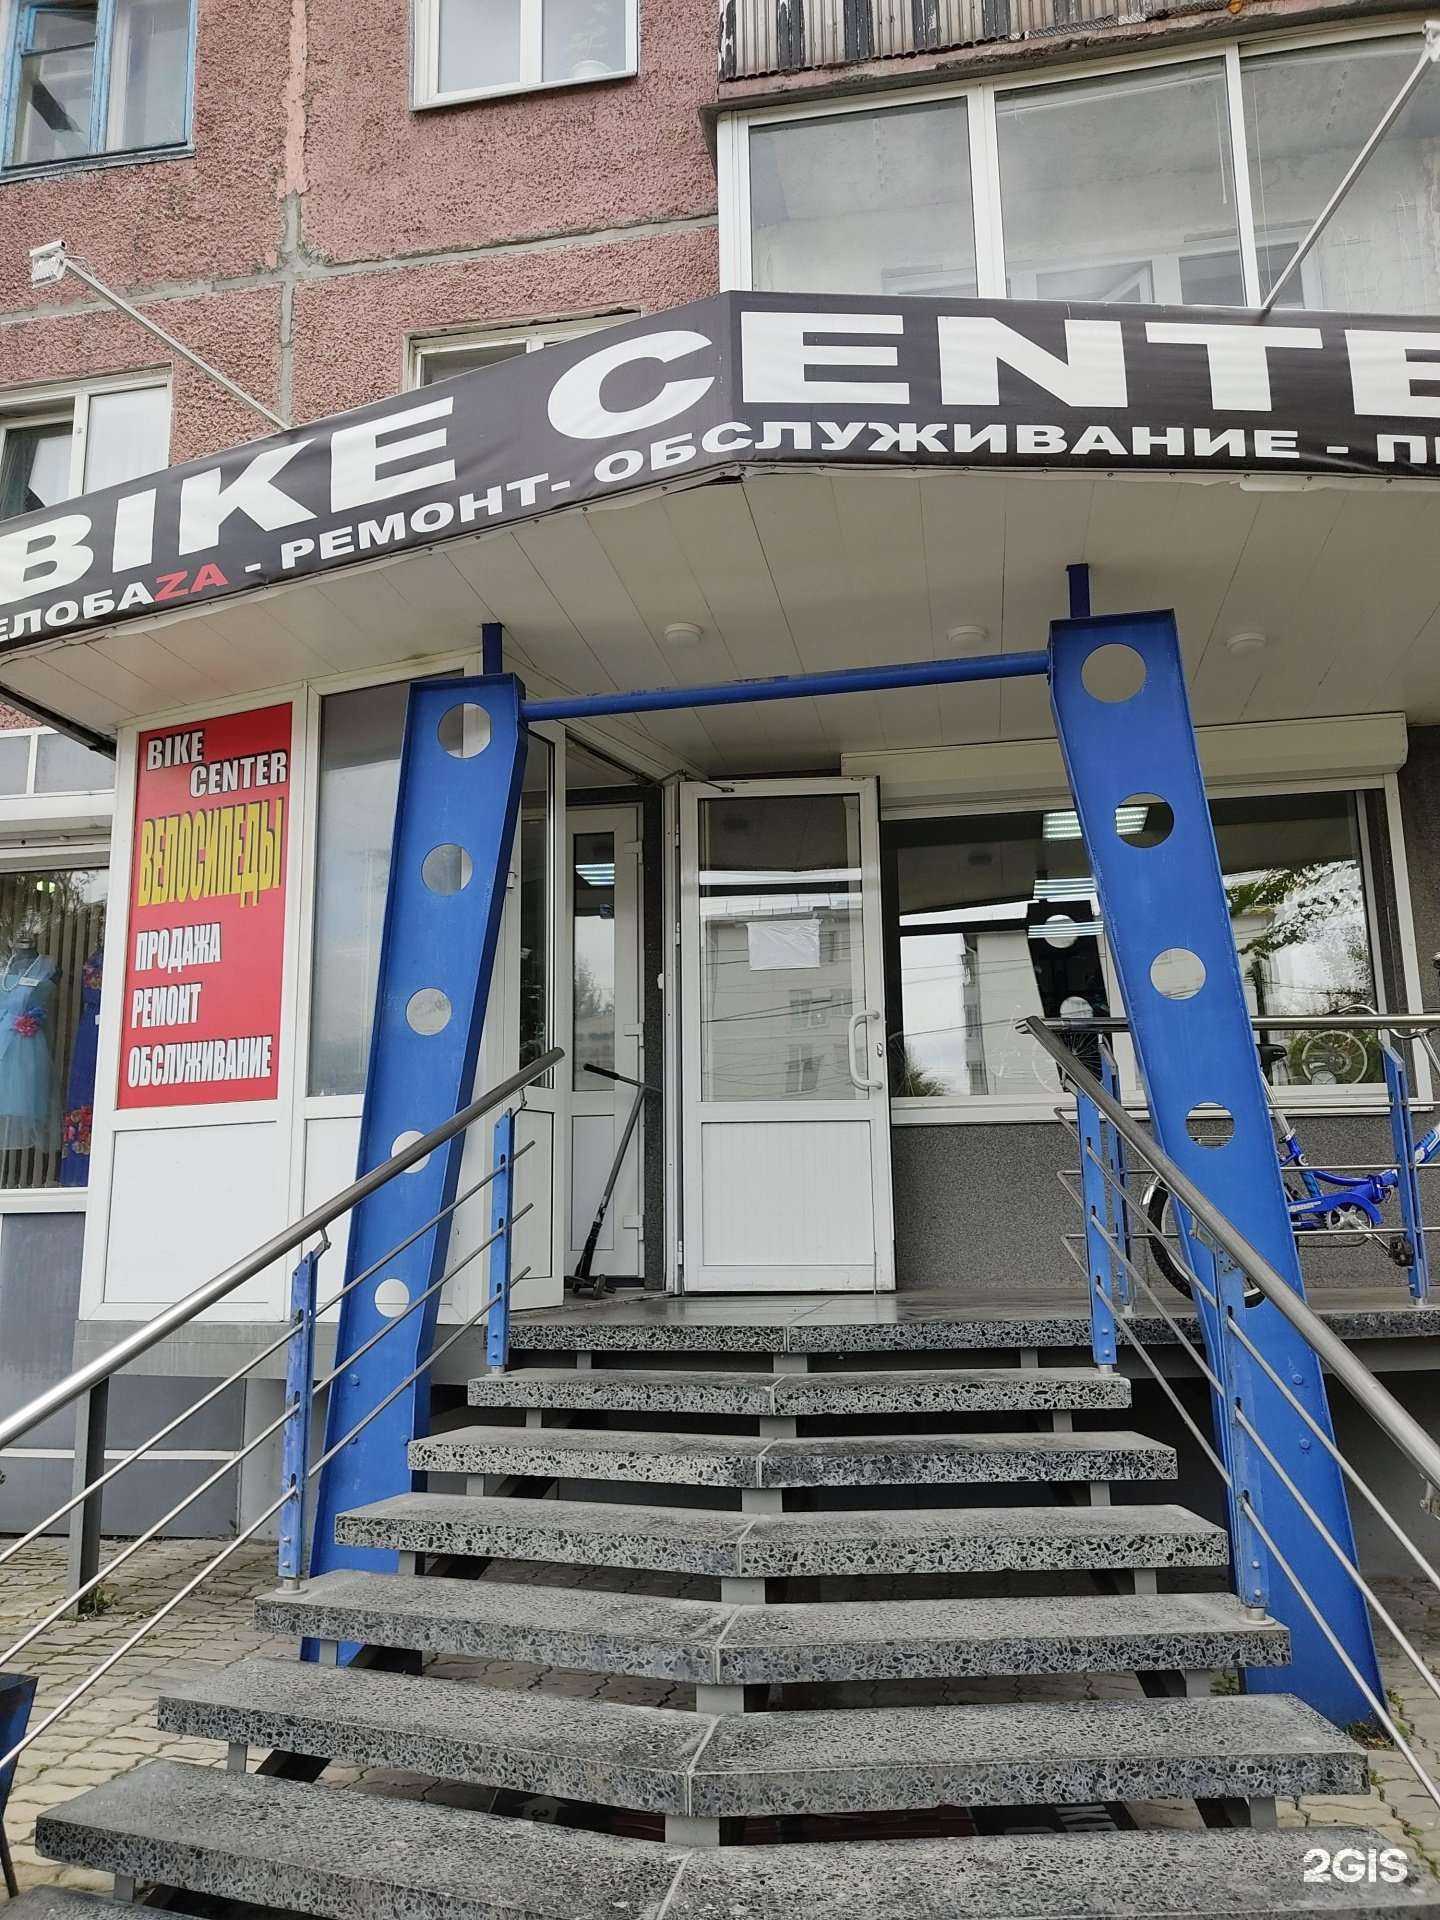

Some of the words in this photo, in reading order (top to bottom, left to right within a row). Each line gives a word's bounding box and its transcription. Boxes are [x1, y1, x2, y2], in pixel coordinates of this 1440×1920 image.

[594, 421, 1300, 483] ОБСЛУЖИВАНИЕ
[1376, 434, 1440, 465] П
[0, 396, 457, 605] BIKE
[147, 730, 205, 771] BIKE
[189, 750, 288, 798] CENTER
[137, 797, 284, 908] ВЕЛОСИПЕДЫ
[135, 921, 222, 973] ПРОДАЖА
[131, 982, 202, 1029] РЕМОНТ
[127, 1035, 273, 1088] ОБСЛУЖИВАНИЕ
